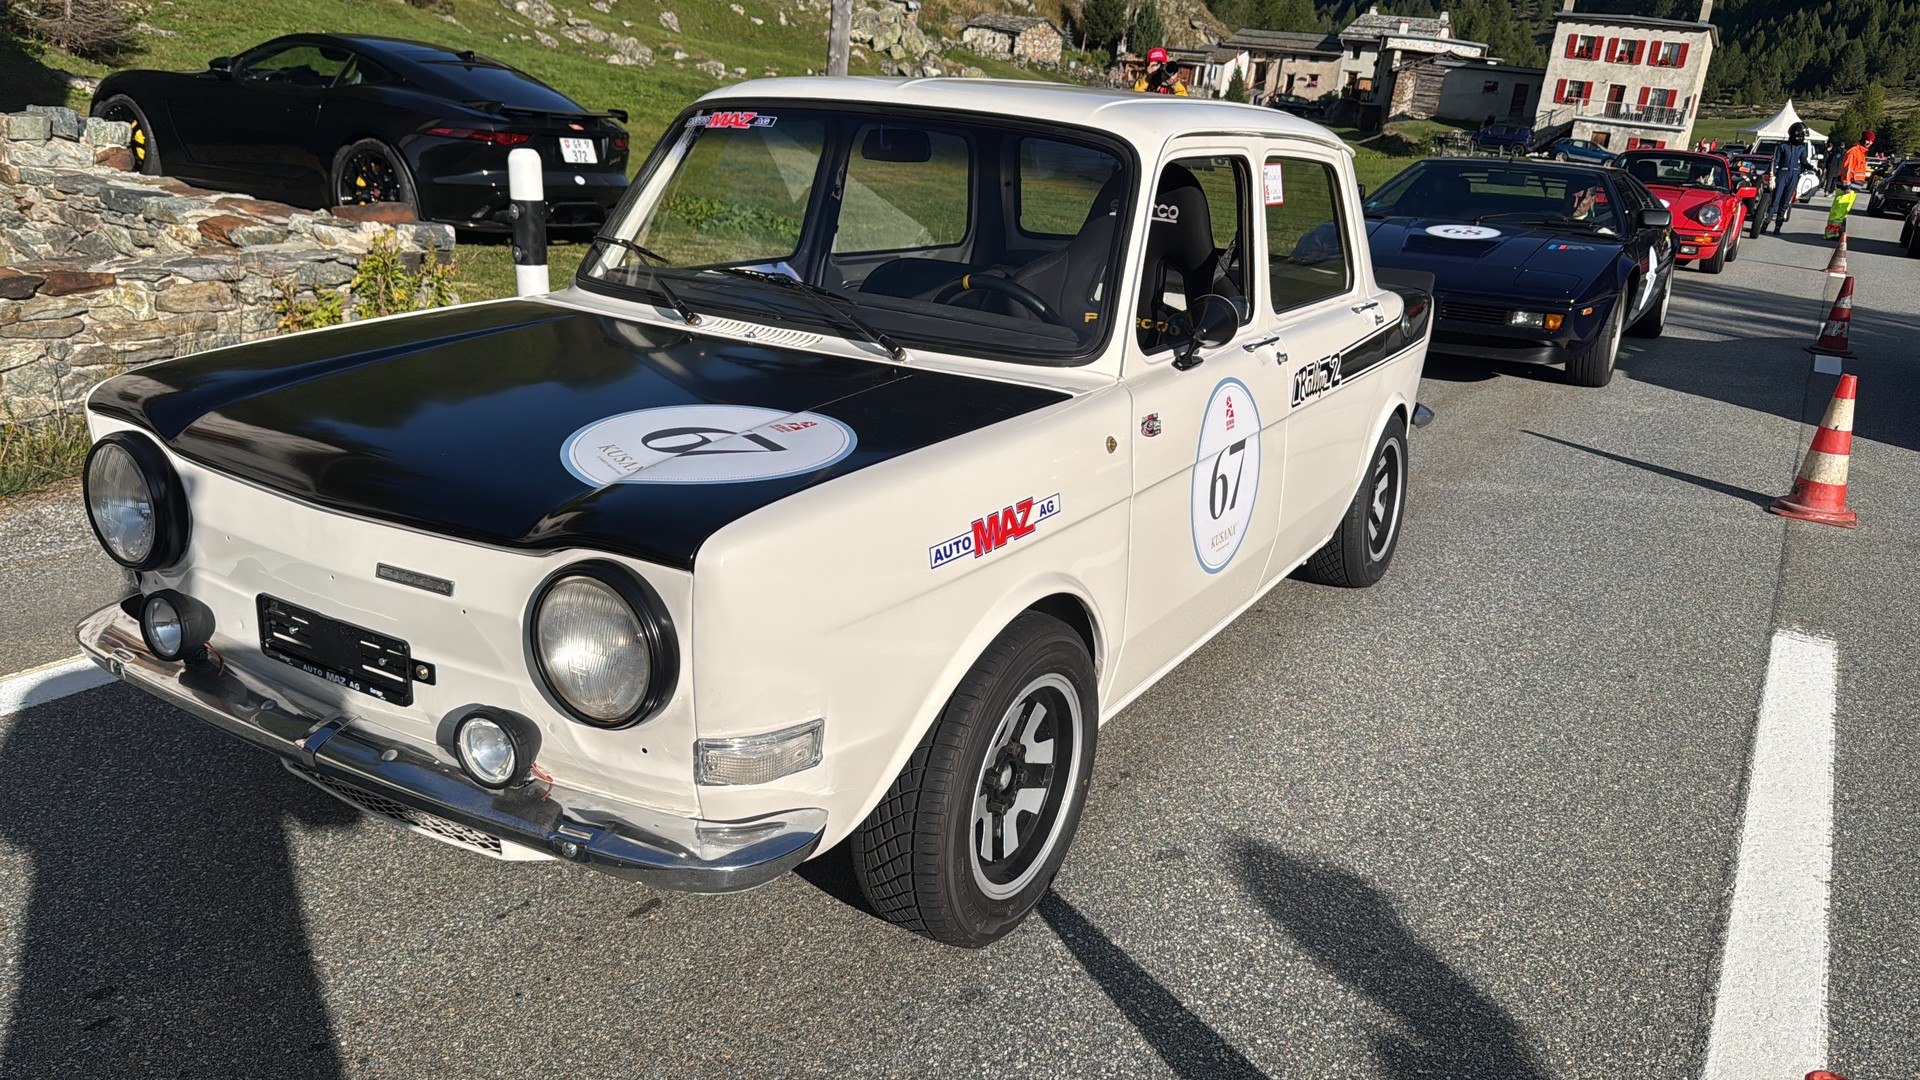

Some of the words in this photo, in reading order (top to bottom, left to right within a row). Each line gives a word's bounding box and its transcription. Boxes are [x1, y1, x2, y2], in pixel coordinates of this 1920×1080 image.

[705, 111, 757, 129] MAZ
[754, 117, 771, 125] AG
[572, 150, 588, 162] 372
[1329, 352, 1342, 388] 2
[641, 426, 789, 457] 67
[1209, 438, 1247, 520] 67
[933, 536, 972, 564] AUTO
[971, 496, 1036, 559] MAZ
[1039, 499, 1055, 518] AG
[1210, 523, 1238, 549] KUSANA
[302, 663, 323, 677] AUTO
[325, 671, 347, 686] MAZ
[349, 681, 361, 691] AG
